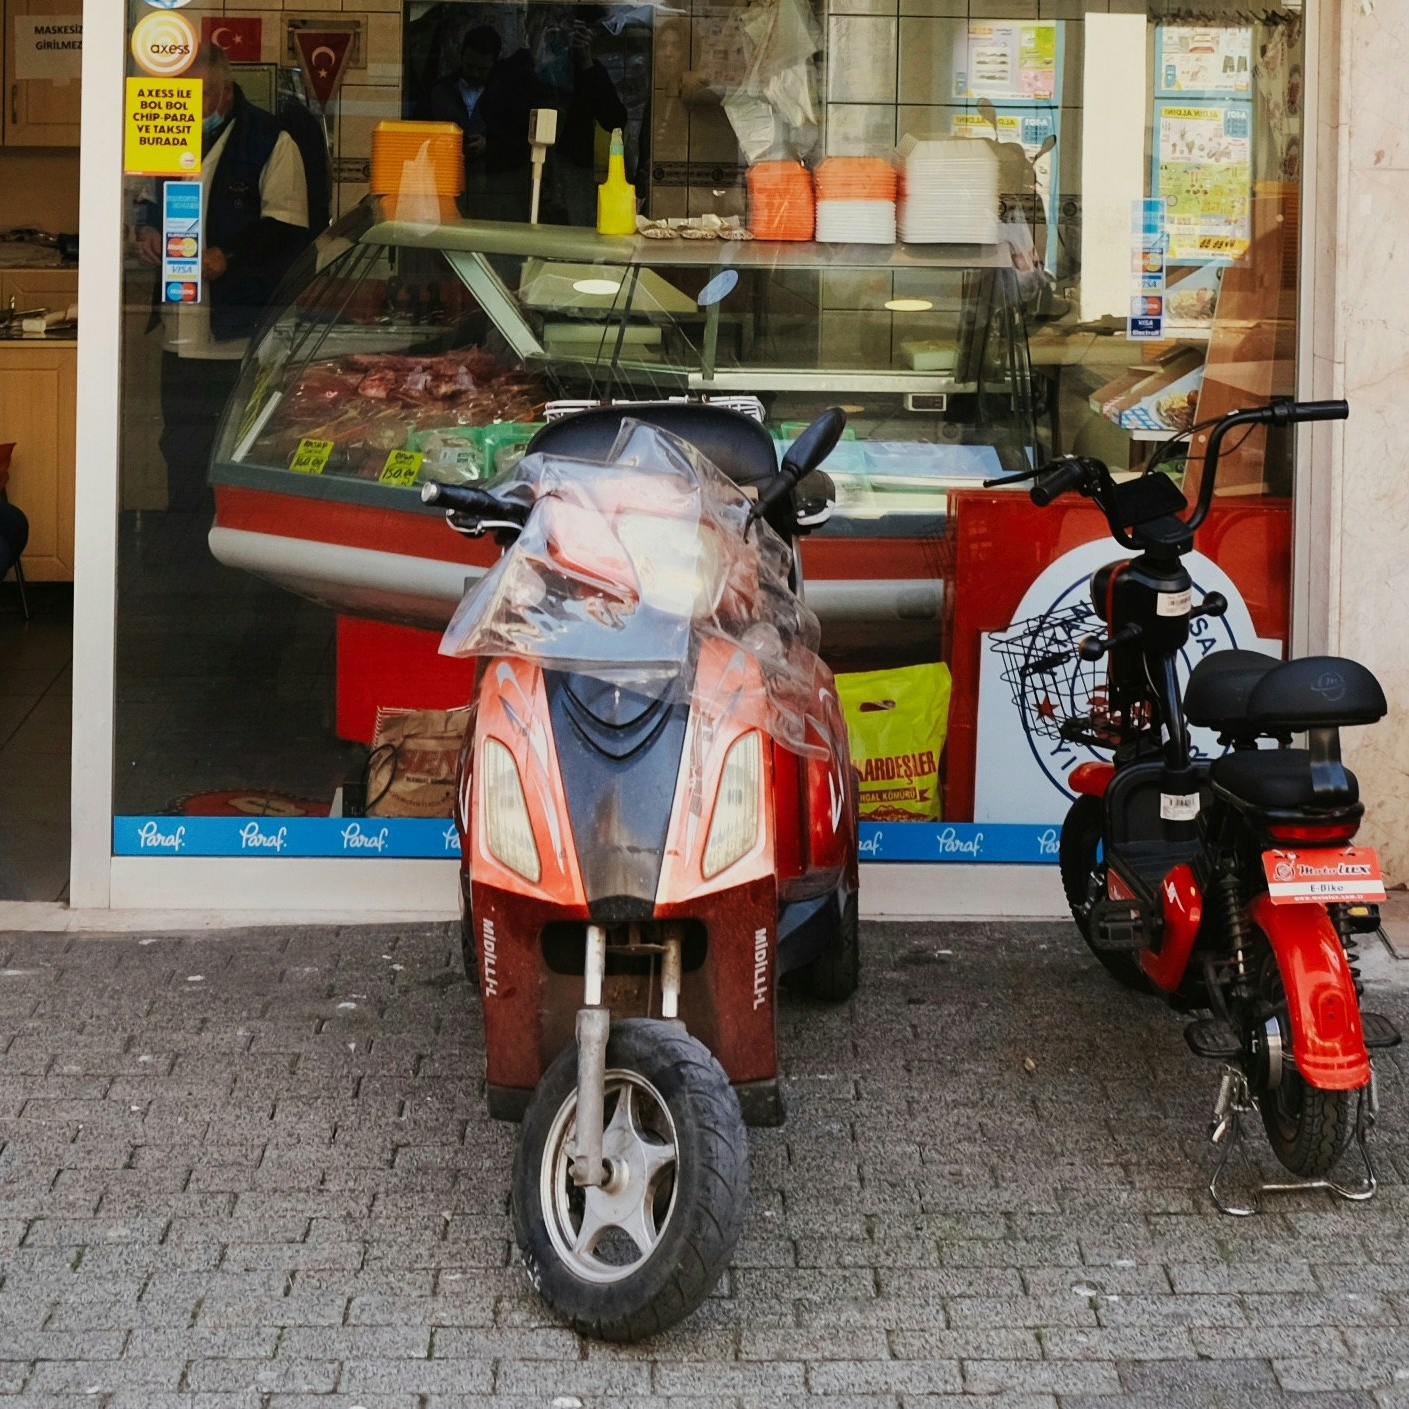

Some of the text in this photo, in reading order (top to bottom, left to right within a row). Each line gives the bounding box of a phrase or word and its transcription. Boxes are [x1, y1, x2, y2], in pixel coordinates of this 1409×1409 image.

[34, 24, 84, 35] MASKESİZ
[35, 39, 83, 51] GİRİLMEZ
[150, 43, 191, 56] axess
[137, 86, 192, 99] AXESS İLE
[140, 100, 188, 111] BOL BOL
[136, 124, 150, 134] VE
[139, 136, 188, 147] BURADA
[172, 265, 193, 274] VISA
[1137, 319, 1154, 327] VISA
[1310, 884, 1344, 893] E-Bike
